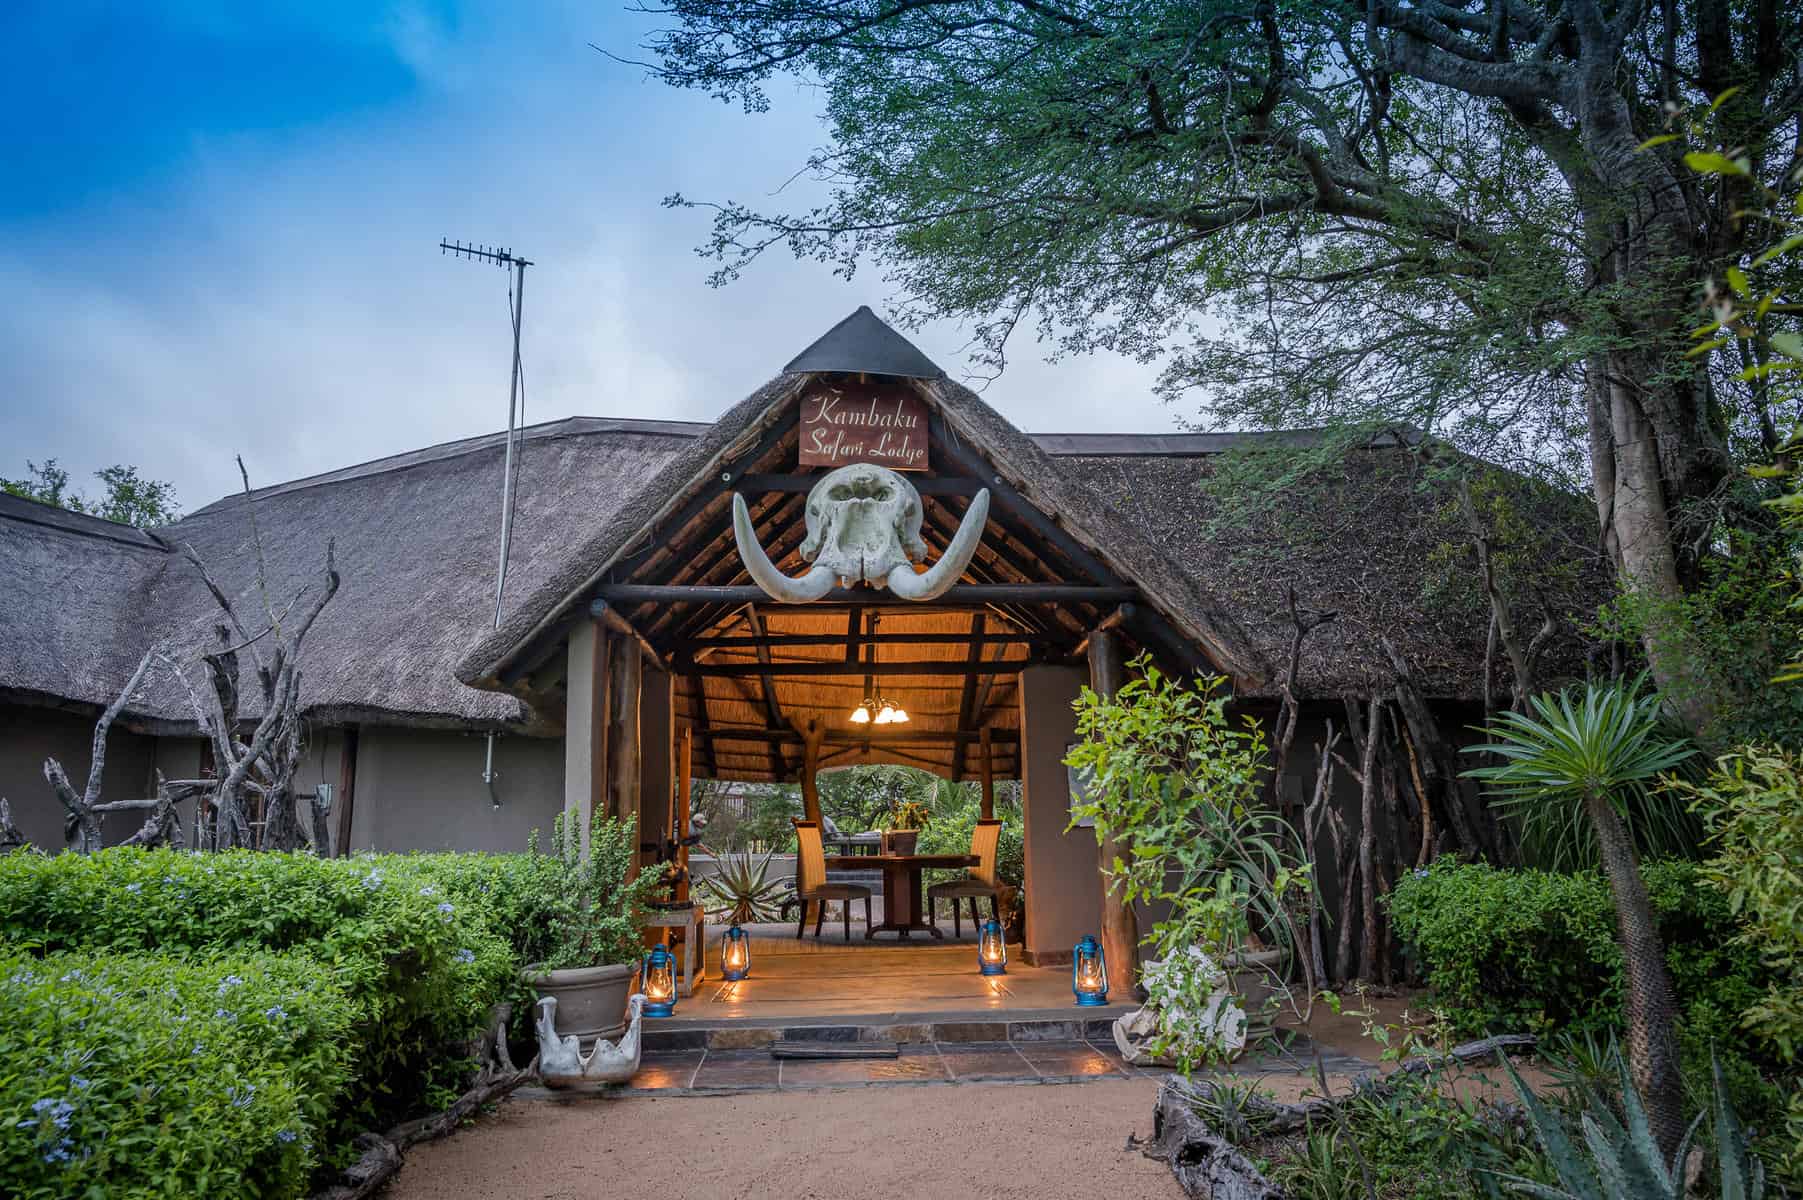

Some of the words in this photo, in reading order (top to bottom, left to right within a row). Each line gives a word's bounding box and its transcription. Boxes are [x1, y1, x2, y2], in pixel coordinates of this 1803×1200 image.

[805, 389, 918, 429] Kambaku
[805, 427, 864, 462] Safari
[868, 431, 924, 465] Lodge
